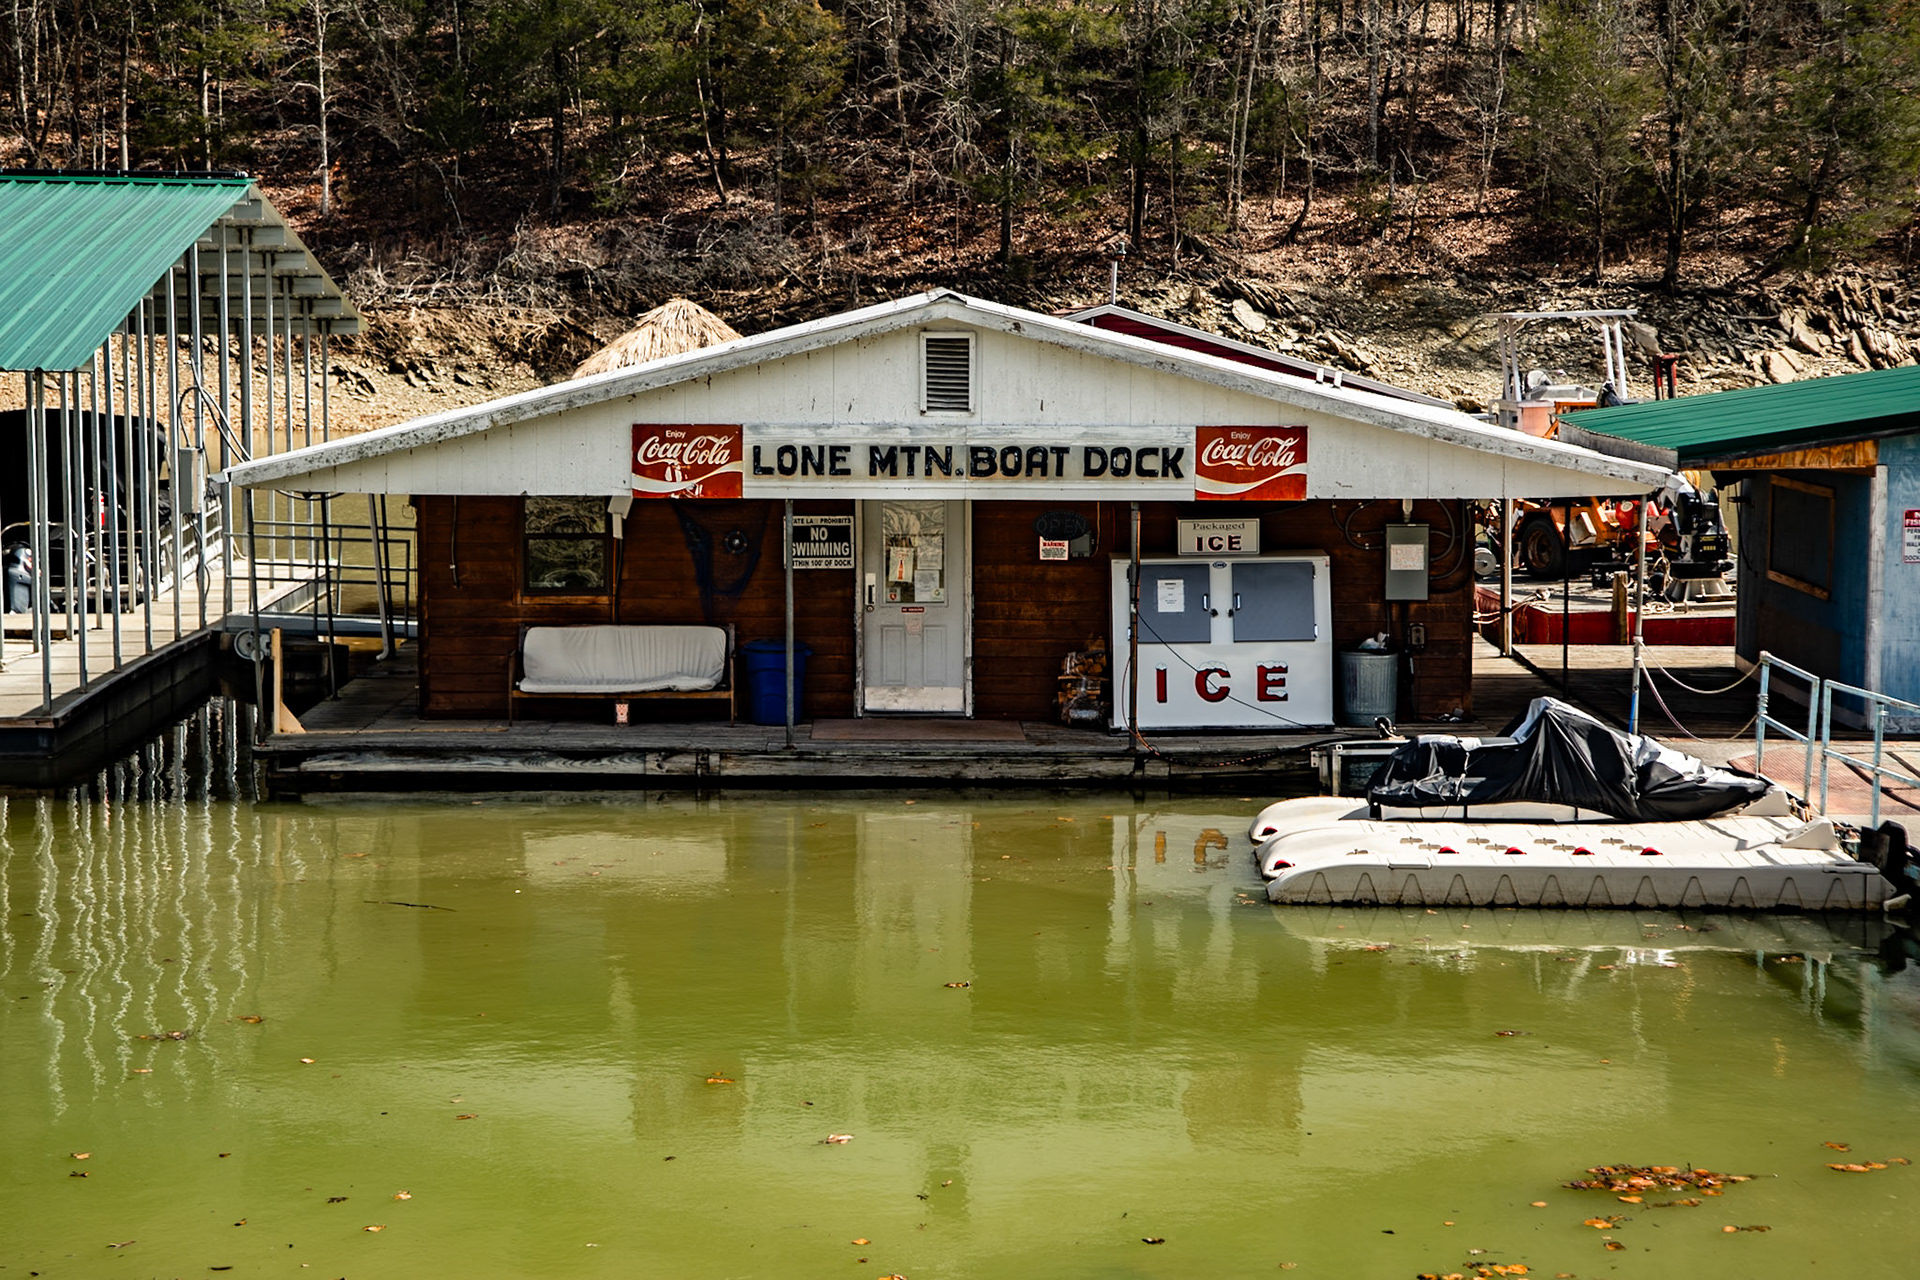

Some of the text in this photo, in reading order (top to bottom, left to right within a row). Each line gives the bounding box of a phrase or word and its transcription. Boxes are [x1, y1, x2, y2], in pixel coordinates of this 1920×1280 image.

[665, 429, 686, 438] Enjoy
[1230, 431, 1251, 440] Enjoy
[637, 435, 735, 466] Coca-Cola
[1201, 436, 1300, 467] Coca-Cola
[753, 445, 1185, 479] LONE MTN. BOAT DOCK
[1036, 518, 1087, 533] OPEN
[1192, 522, 1245, 531] Packaged
[810, 526, 828, 541] NO
[792, 542, 850, 556] SWIMMING
[1196, 534, 1242, 551] ICE
[1155, 660, 1289, 704] ICE
